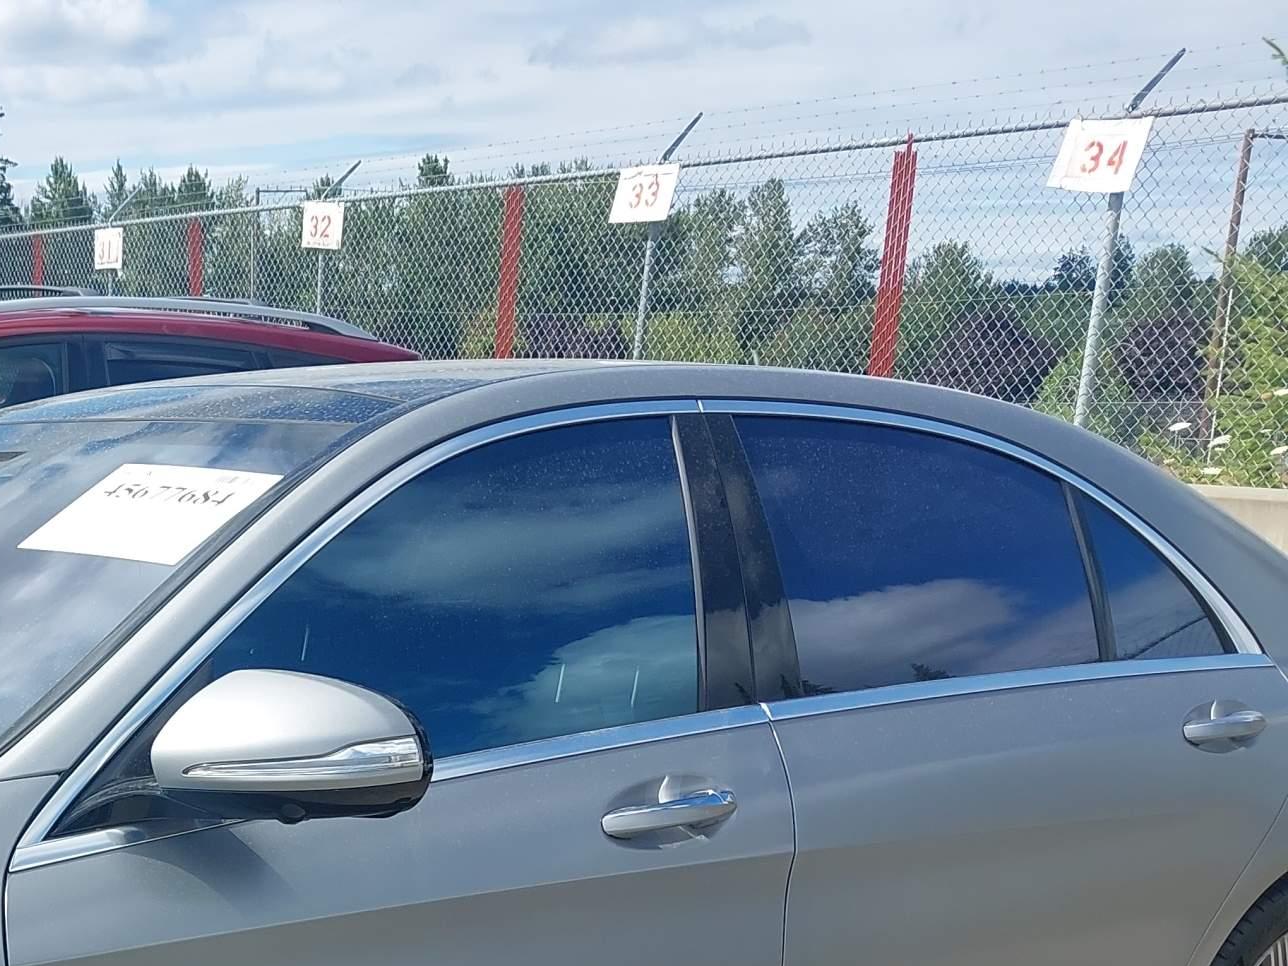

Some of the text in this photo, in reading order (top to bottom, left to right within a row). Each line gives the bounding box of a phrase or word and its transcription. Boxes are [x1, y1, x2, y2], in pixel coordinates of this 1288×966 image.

[1080, 140, 1128, 175] 34
[629, 181, 660, 208] 33
[310, 215, 332, 239] 32
[103, 483, 235, 506] 45677684
